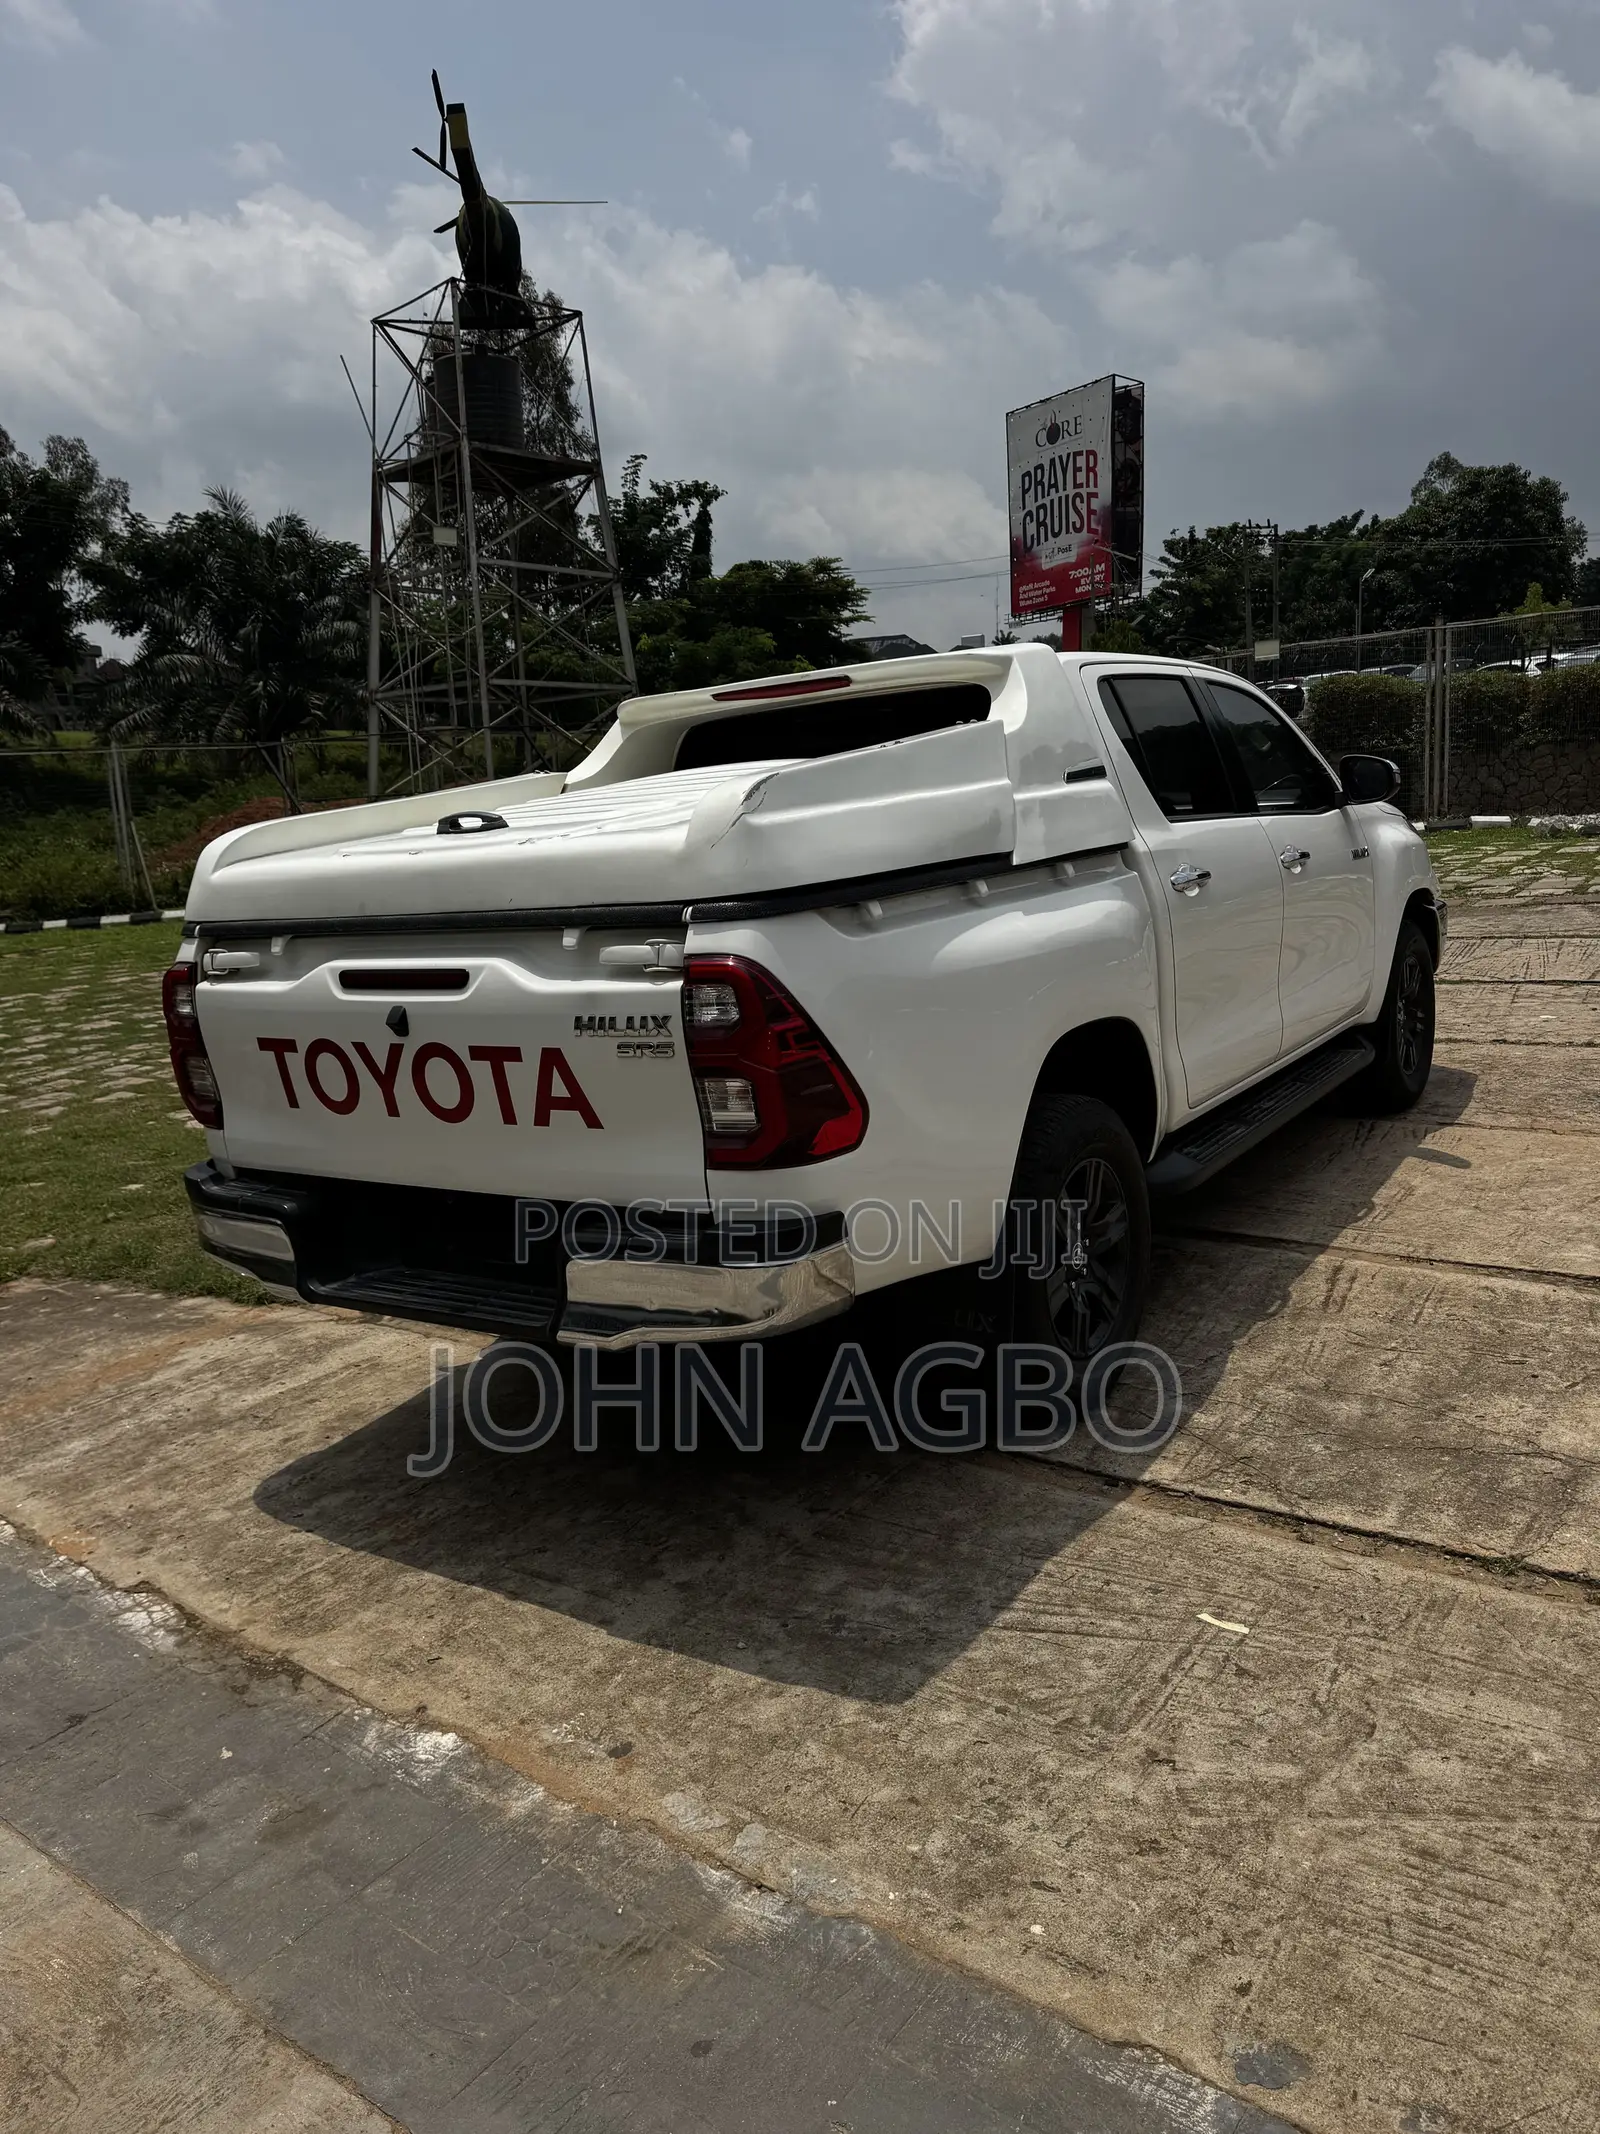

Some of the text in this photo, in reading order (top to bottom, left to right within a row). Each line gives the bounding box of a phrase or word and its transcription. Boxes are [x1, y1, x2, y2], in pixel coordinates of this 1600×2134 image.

[1021, 449, 1098, 510] PRAYER
[1022, 492, 1099, 552] CRUISE
[1081, 573, 1105, 584] EVRY
[573, 1014, 673, 1037] HILUX
[616, 1041, 675, 1058] SR5
[256, 1036, 604, 1130] TOYOTA
